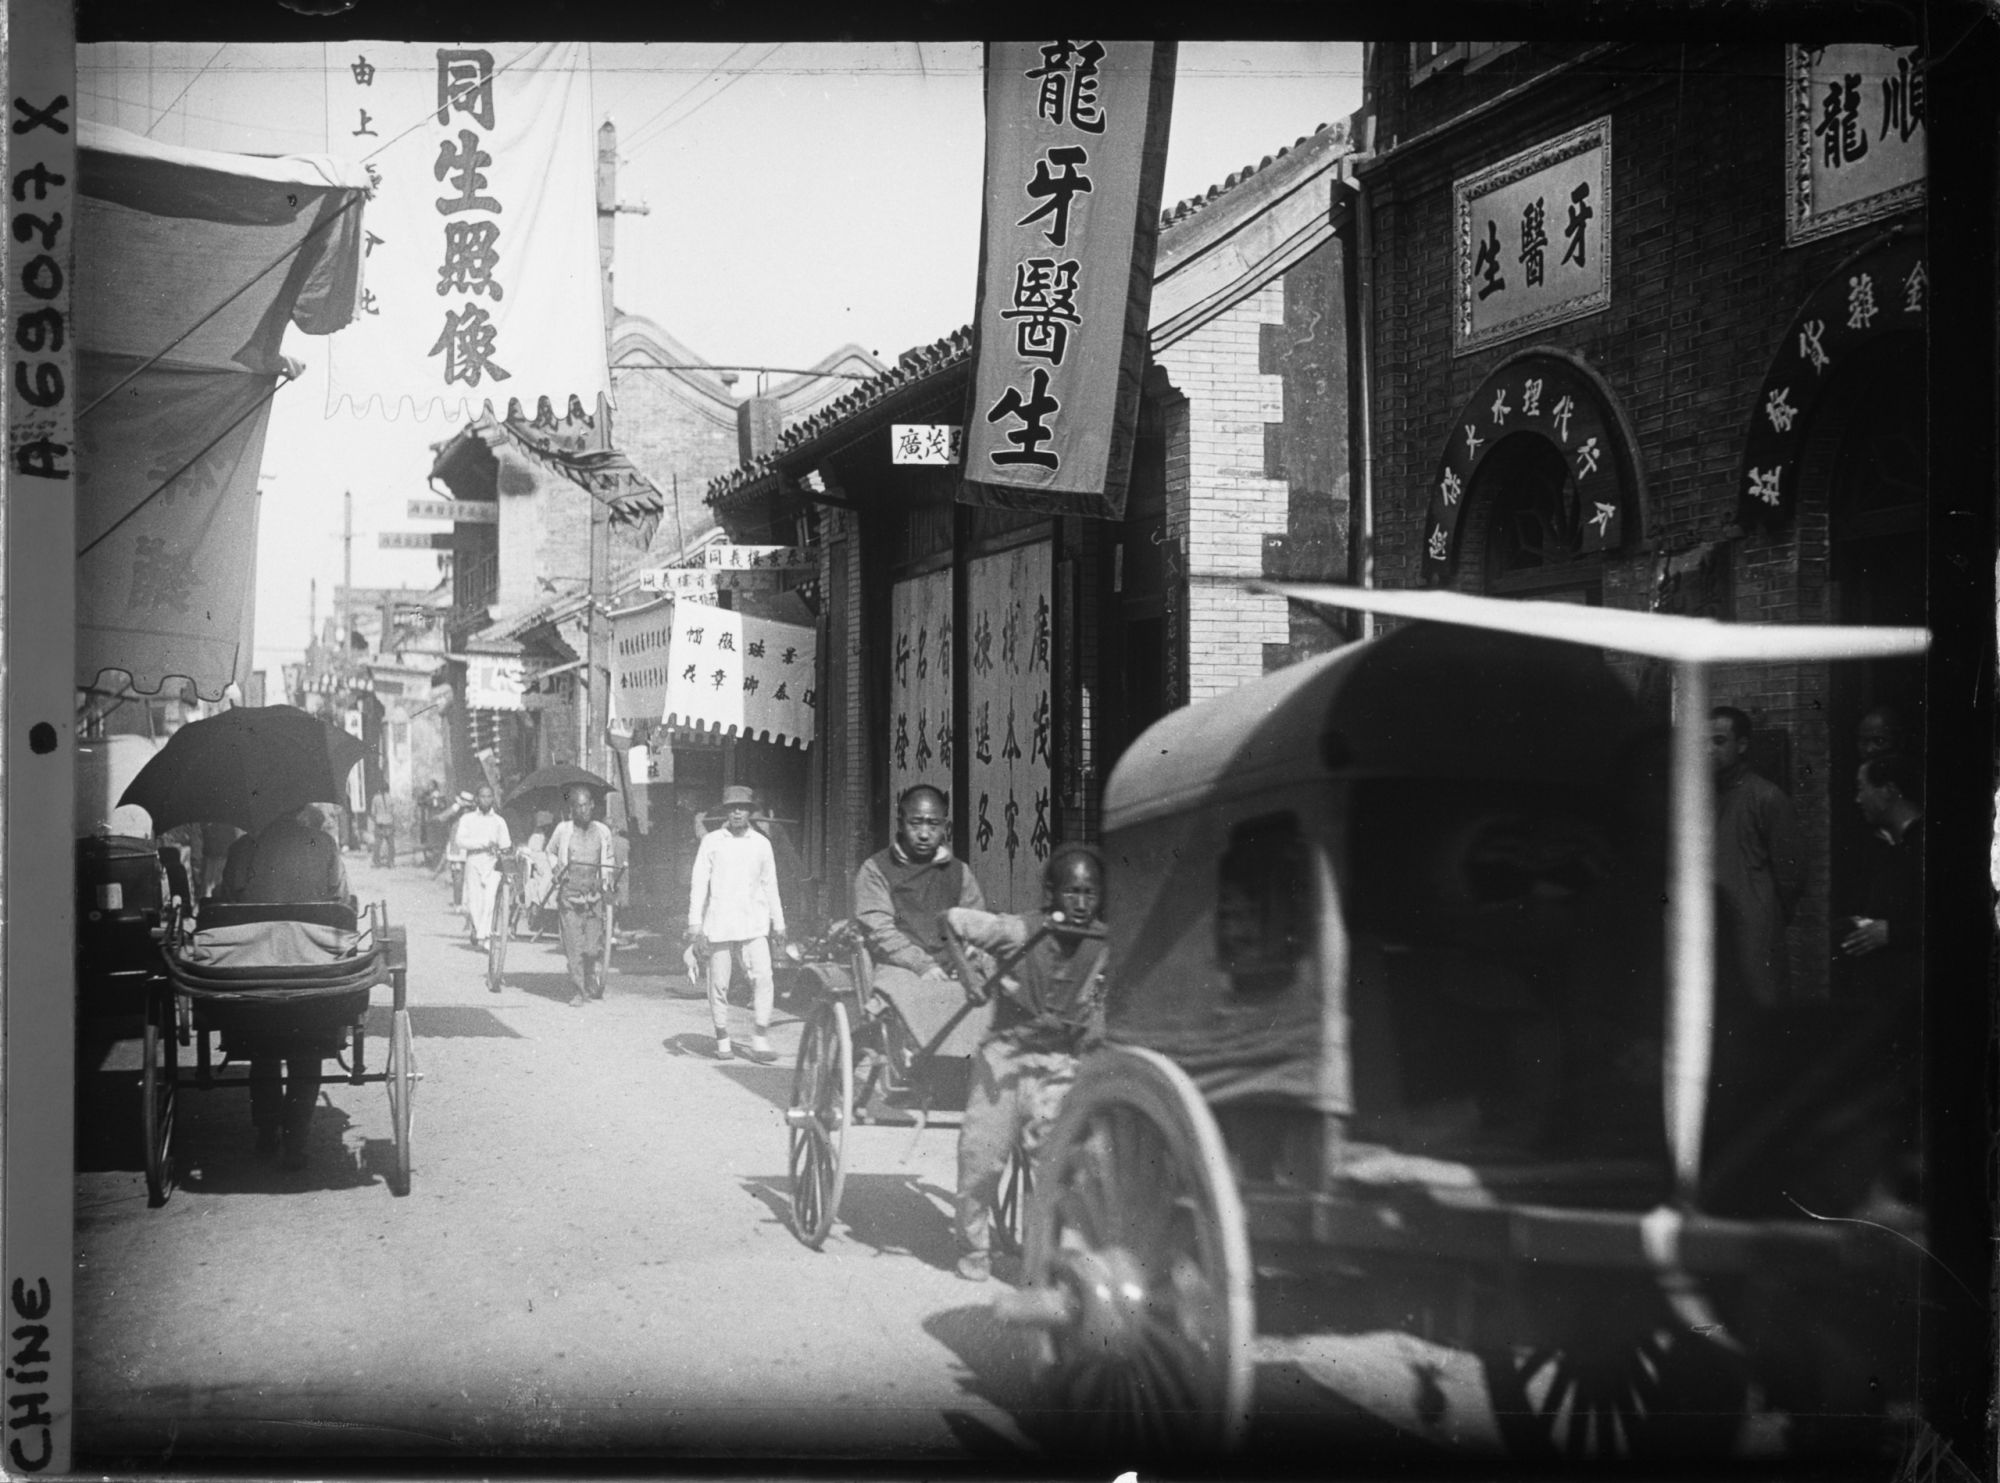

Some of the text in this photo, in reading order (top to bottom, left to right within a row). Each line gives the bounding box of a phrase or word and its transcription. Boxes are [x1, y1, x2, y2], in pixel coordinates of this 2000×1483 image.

[428, 48, 511, 388] 同生照像
[1475, 181, 1593, 300] 牙醫生
